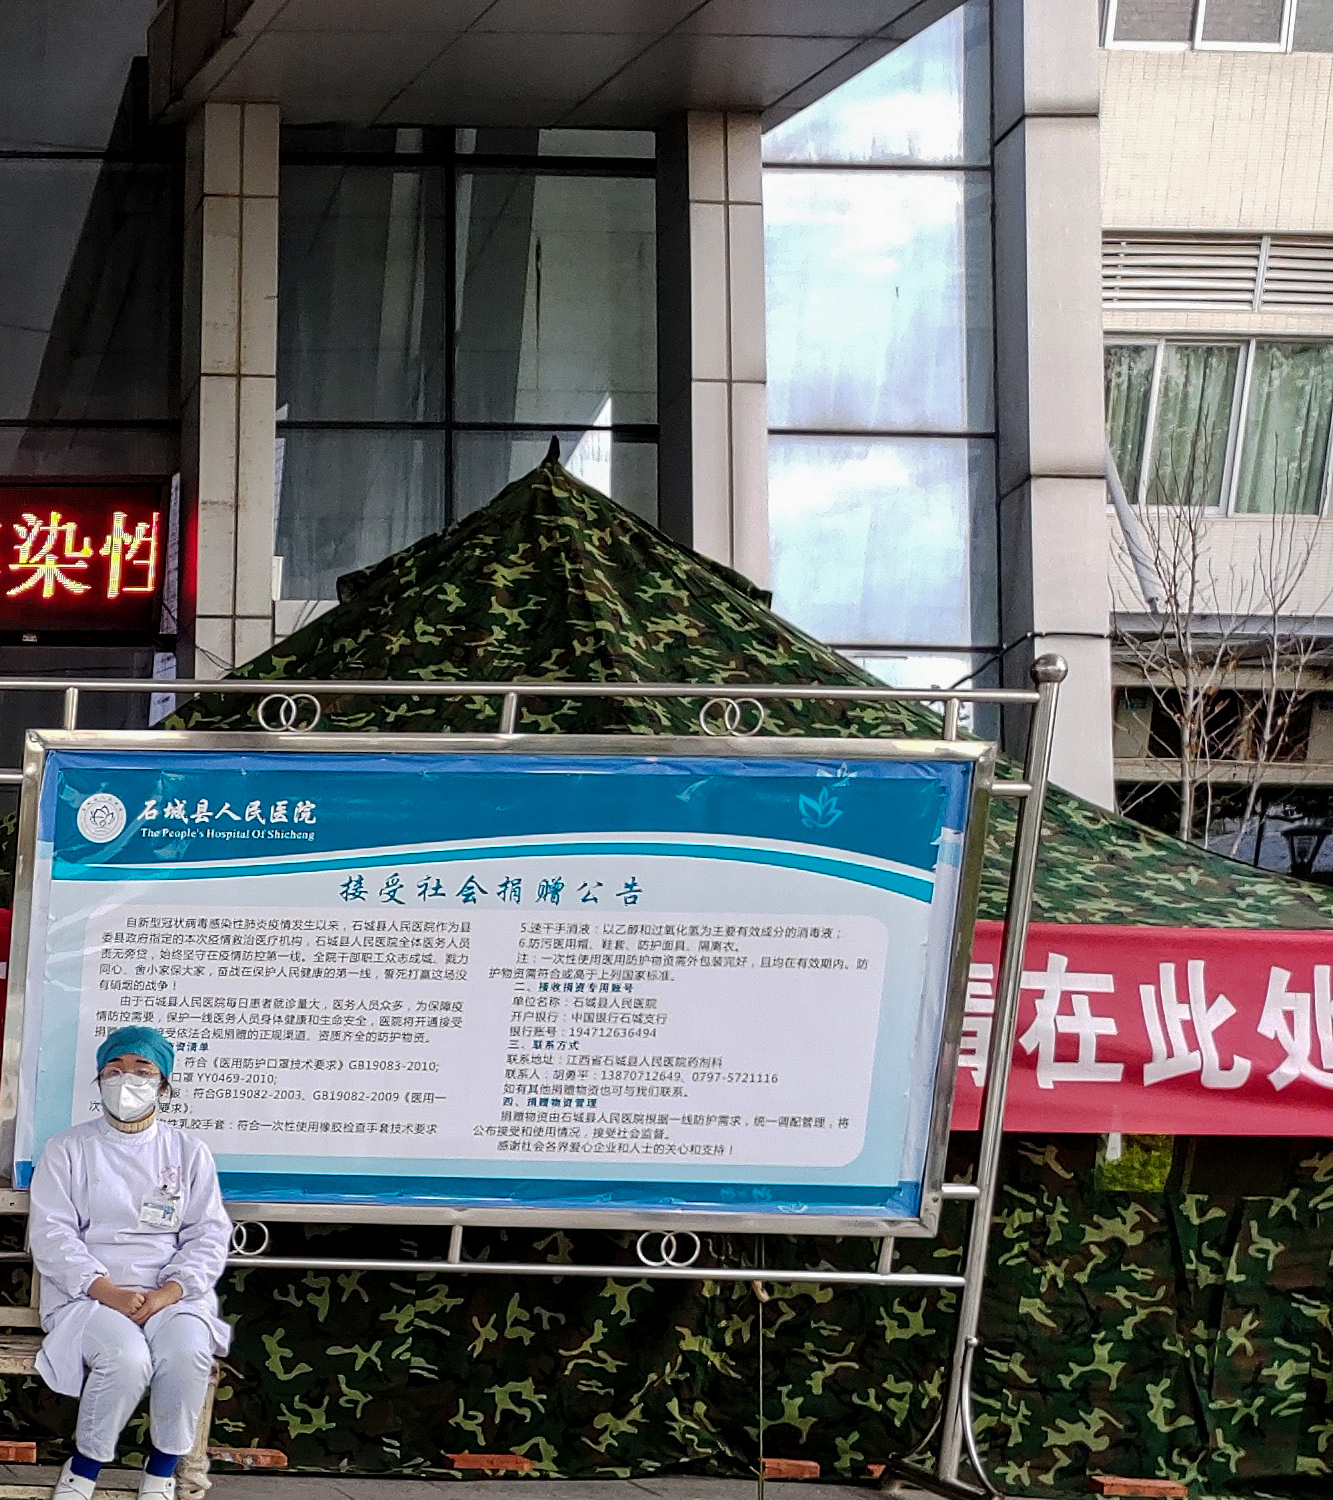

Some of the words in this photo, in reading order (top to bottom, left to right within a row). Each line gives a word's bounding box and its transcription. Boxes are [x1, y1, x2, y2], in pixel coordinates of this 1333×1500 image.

[137, 798, 317, 825] 石城县人民医院
[140, 827, 160, 837] The
[162, 827, 204, 840] People's
[206, 828, 250, 840] Hospital
[251, 829, 265, 838] Of
[267, 829, 316, 843] Shicheng
[338, 872, 645, 907] 接受社会捐赠公告
